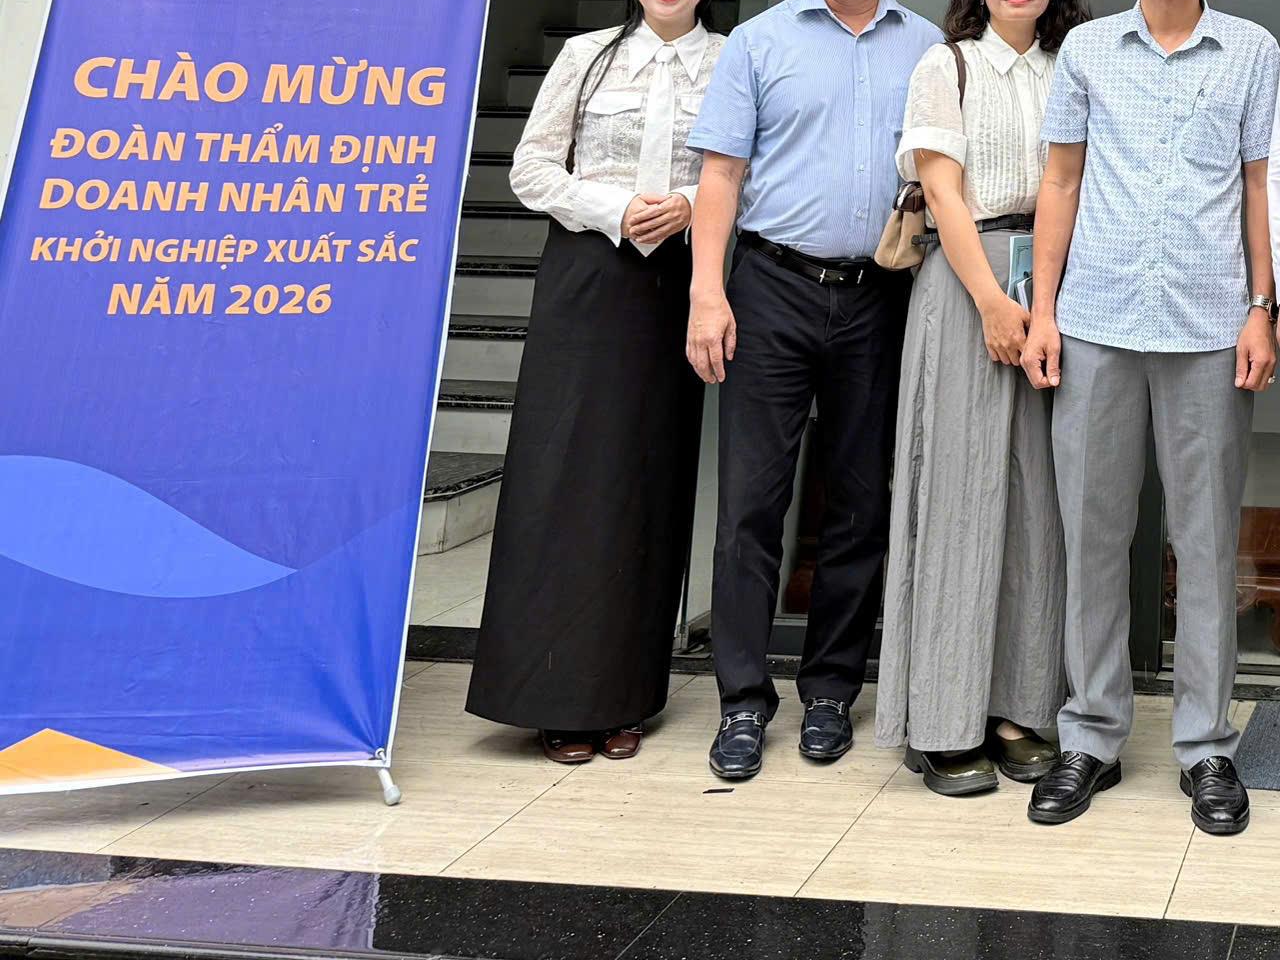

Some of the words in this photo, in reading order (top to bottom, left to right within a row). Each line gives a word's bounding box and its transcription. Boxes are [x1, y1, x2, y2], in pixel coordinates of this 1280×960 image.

[73, 51, 249, 102] CHÀO
[261, 56, 447, 106] MỪNG
[50, 124, 186, 161] ĐOÀN
[195, 123, 319, 164] THẨM
[330, 134, 436, 174] ĐỊNH
[39, 178, 211, 213] DOANH
[218, 176, 344, 213] NHÂN
[354, 174, 430, 213] TRẺ
[30, 229, 121, 263] KHỞI
[129, 234, 258, 271] NGHIỆP
[264, 231, 351, 264] XUẤT
[356, 230, 420, 263] SẮC
[107, 276, 216, 316] NĂM
[225, 282, 333, 316] 2026
